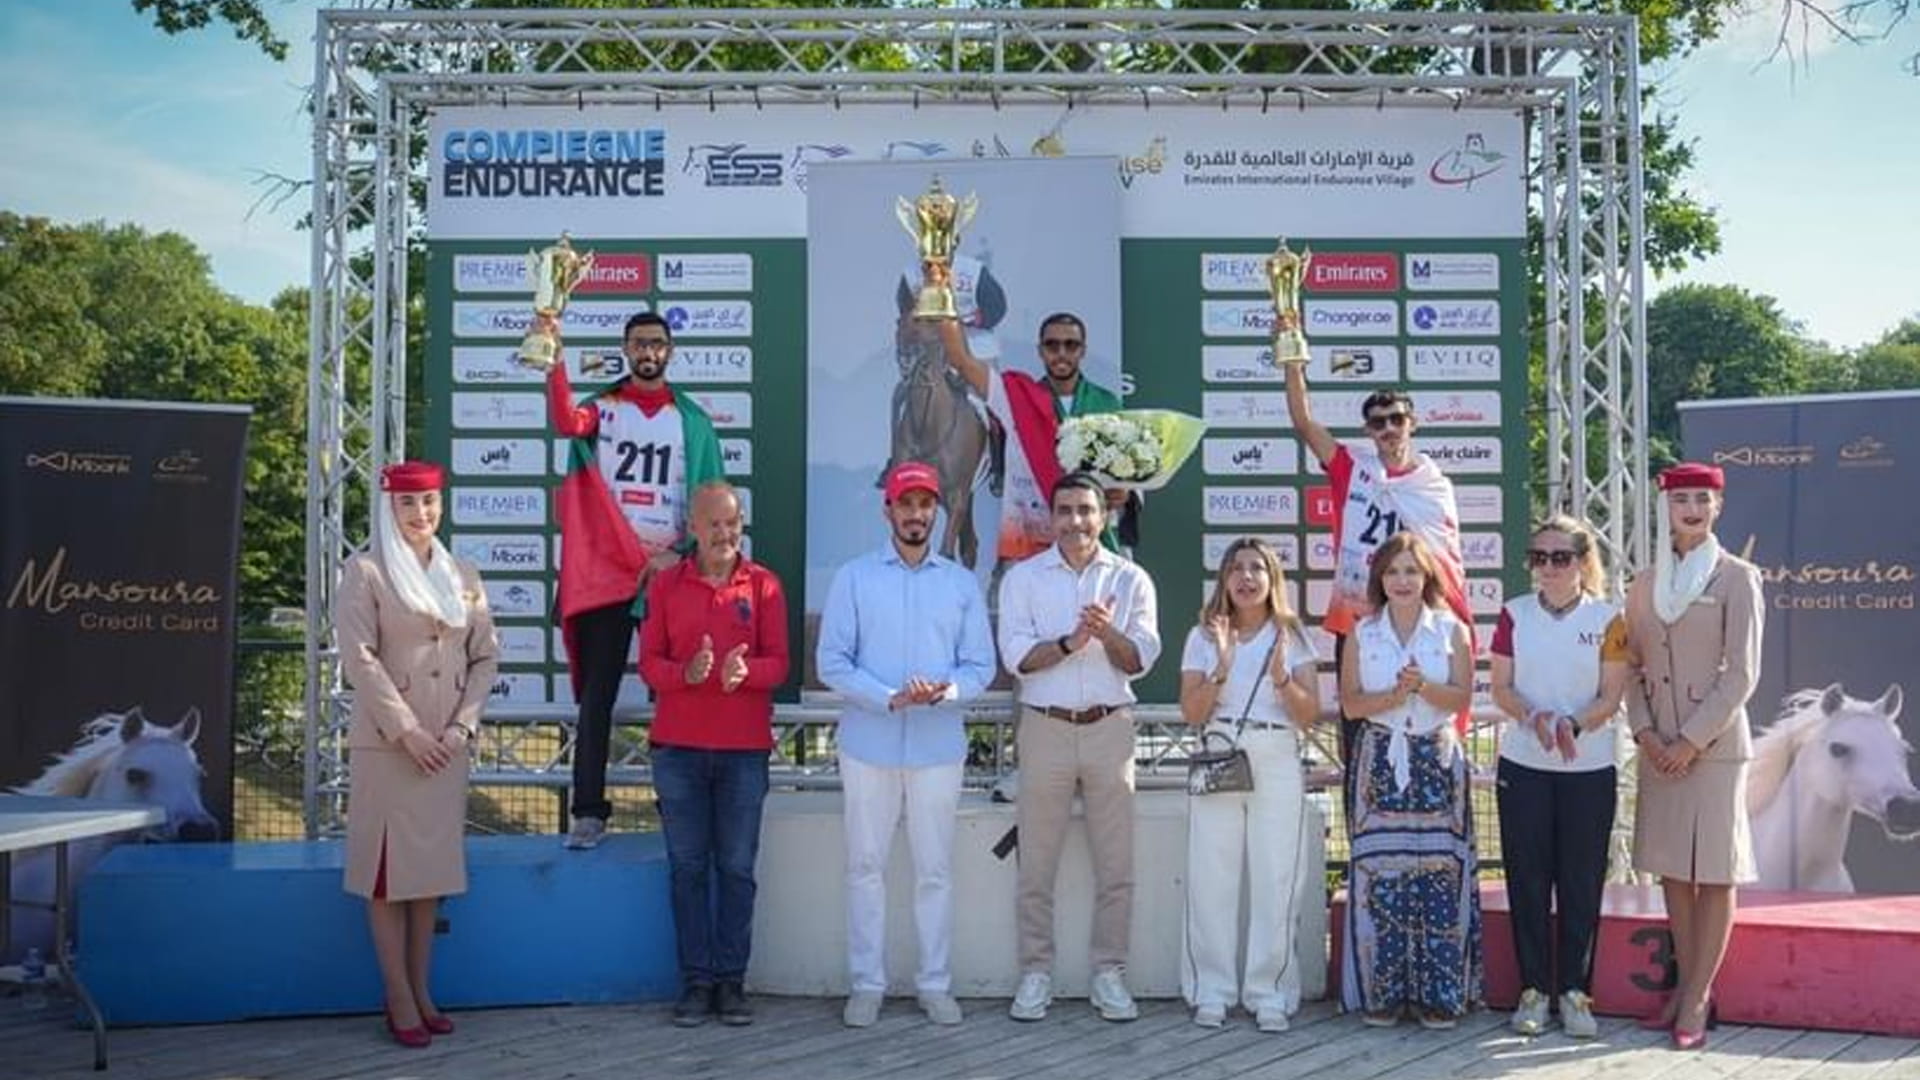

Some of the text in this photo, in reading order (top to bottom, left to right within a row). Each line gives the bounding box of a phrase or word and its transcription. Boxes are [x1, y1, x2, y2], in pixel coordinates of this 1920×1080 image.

[444, 131, 665, 163] COMPIEGNE
[1240, 150, 1306, 169] العالمية
[444, 162, 665, 197] ENDURANCE
[1184, 173, 1415, 188] Emirates International Endurance Village
[460, 262, 527, 278] PREMIE
[1315, 262, 1389, 282] Emirates
[683, 352, 747, 369] VIIQ
[1415, 350, 1494, 369] EVIIQ
[70, 459, 130, 473] Mbank
[615, 440, 671, 485] 211
[1754, 452, 1813, 464] Mbank
[458, 495, 538, 512] PREMIER
[1208, 494, 1291, 511] PREMIER
[491, 550, 538, 563] Mbank
[7, 546, 221, 613] Mansoura
[1774, 593, 1915, 609] Credit Card
[80, 612, 219, 632] Credit Card
[1629, 927, 1678, 992] 3
